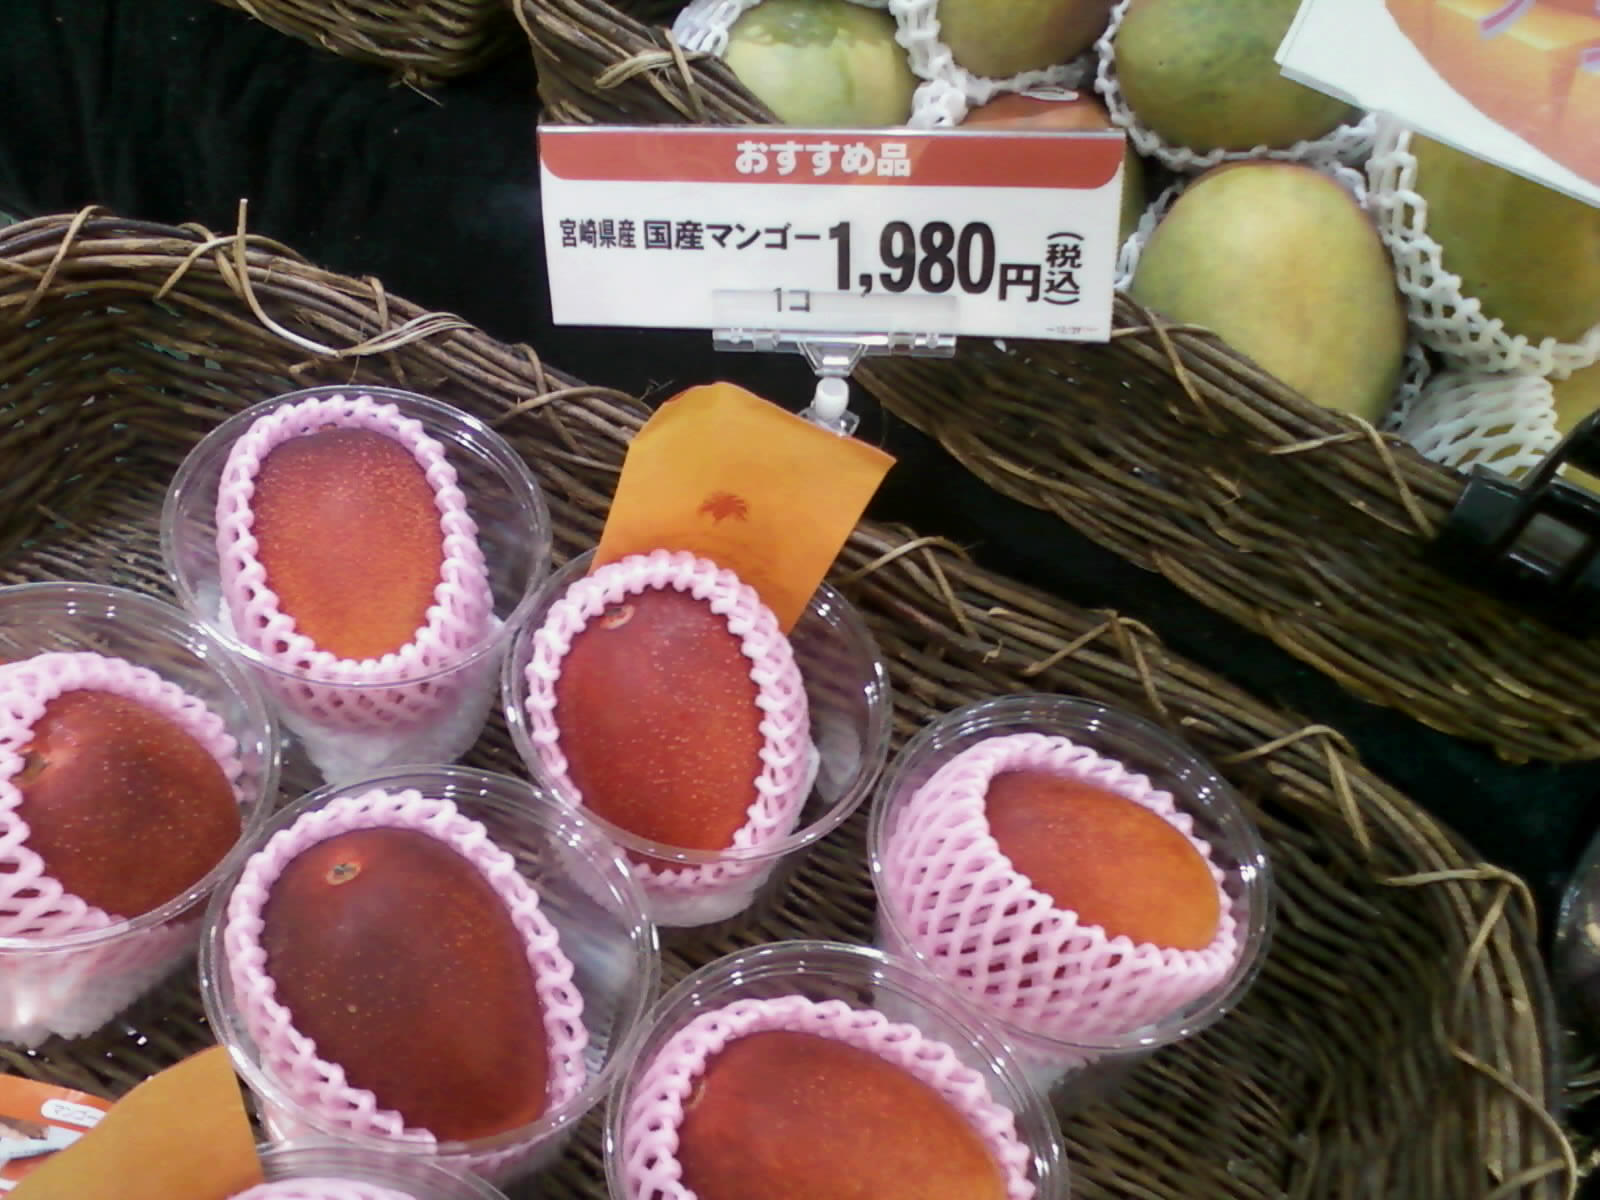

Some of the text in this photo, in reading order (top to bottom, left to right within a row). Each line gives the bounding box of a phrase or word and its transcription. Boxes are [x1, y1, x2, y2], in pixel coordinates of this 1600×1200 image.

[735, 140, 911, 177] おすすめ品
[560, 218, 637, 249] 宮崎県産
[643, 219, 821, 251] 国産マンゴー
[773, 287, 810, 312] 1コ
